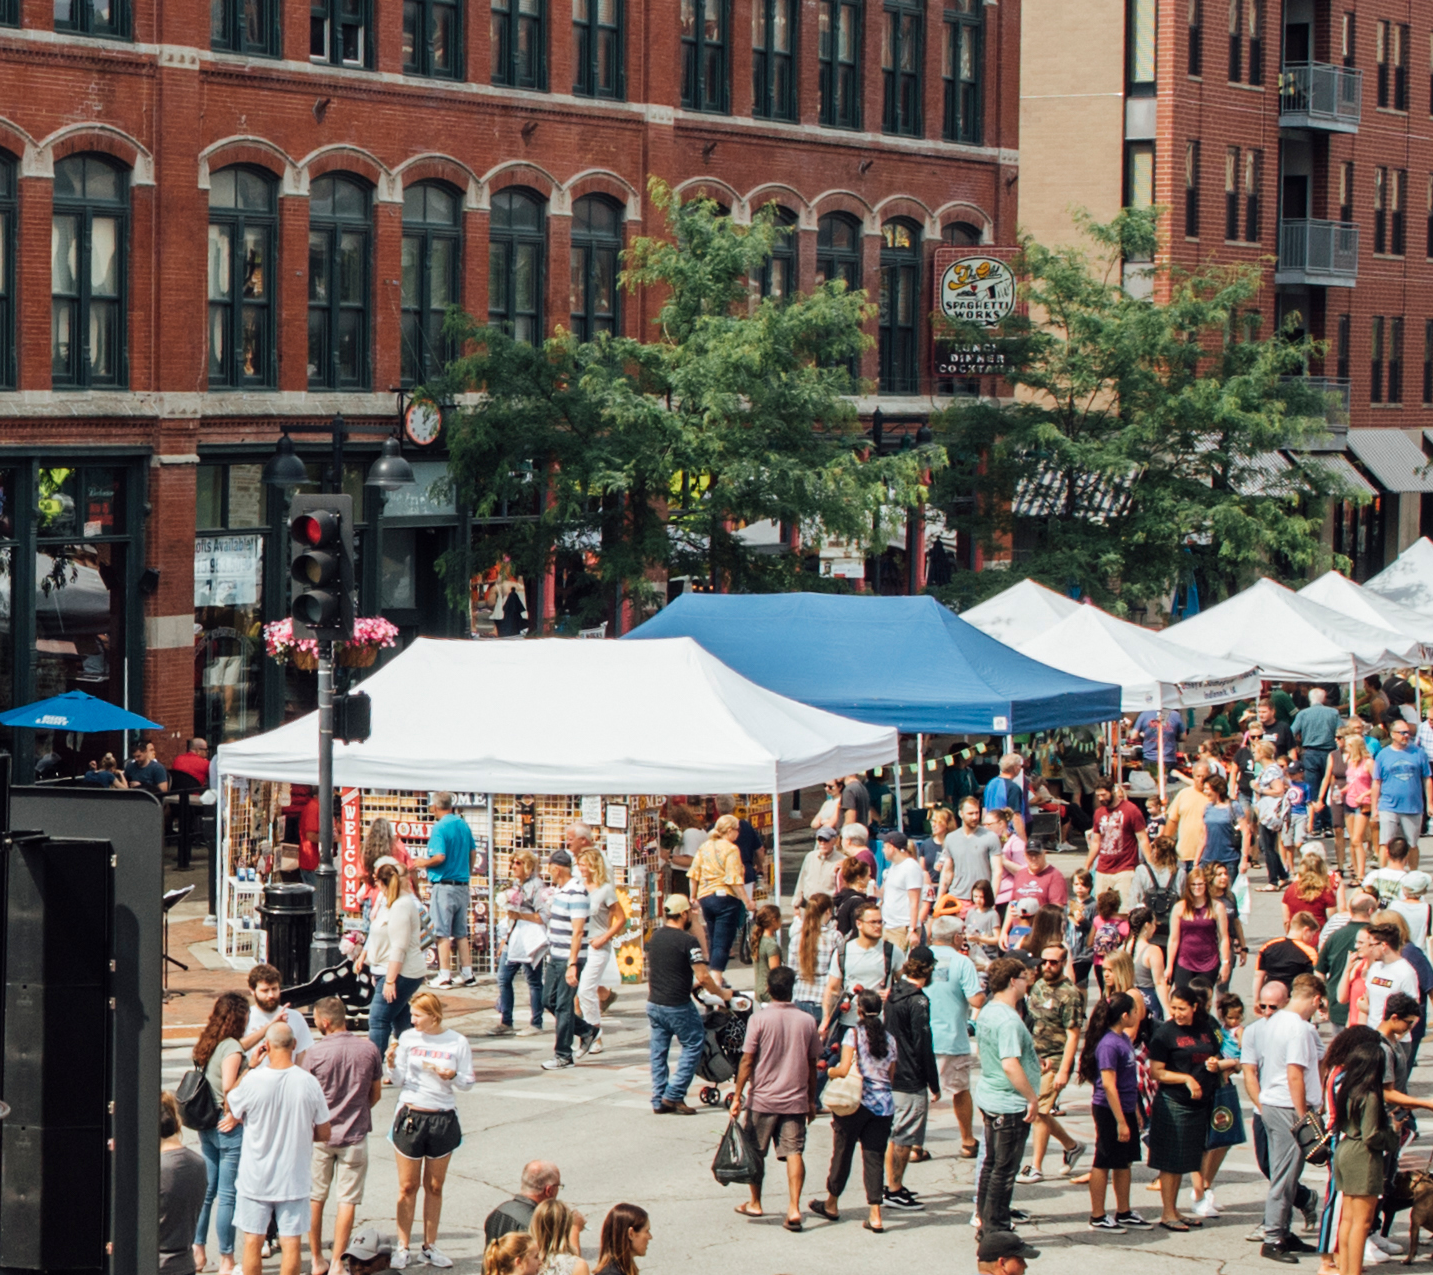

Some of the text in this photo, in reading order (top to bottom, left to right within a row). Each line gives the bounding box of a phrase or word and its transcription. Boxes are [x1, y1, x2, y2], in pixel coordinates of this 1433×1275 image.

[946, 301, 1009, 310] SPAGHETTI
[954, 310, 1001, 319] WORKS
[195, 540, 212, 553] ofts
[343, 804, 357, 909] WELCOME
